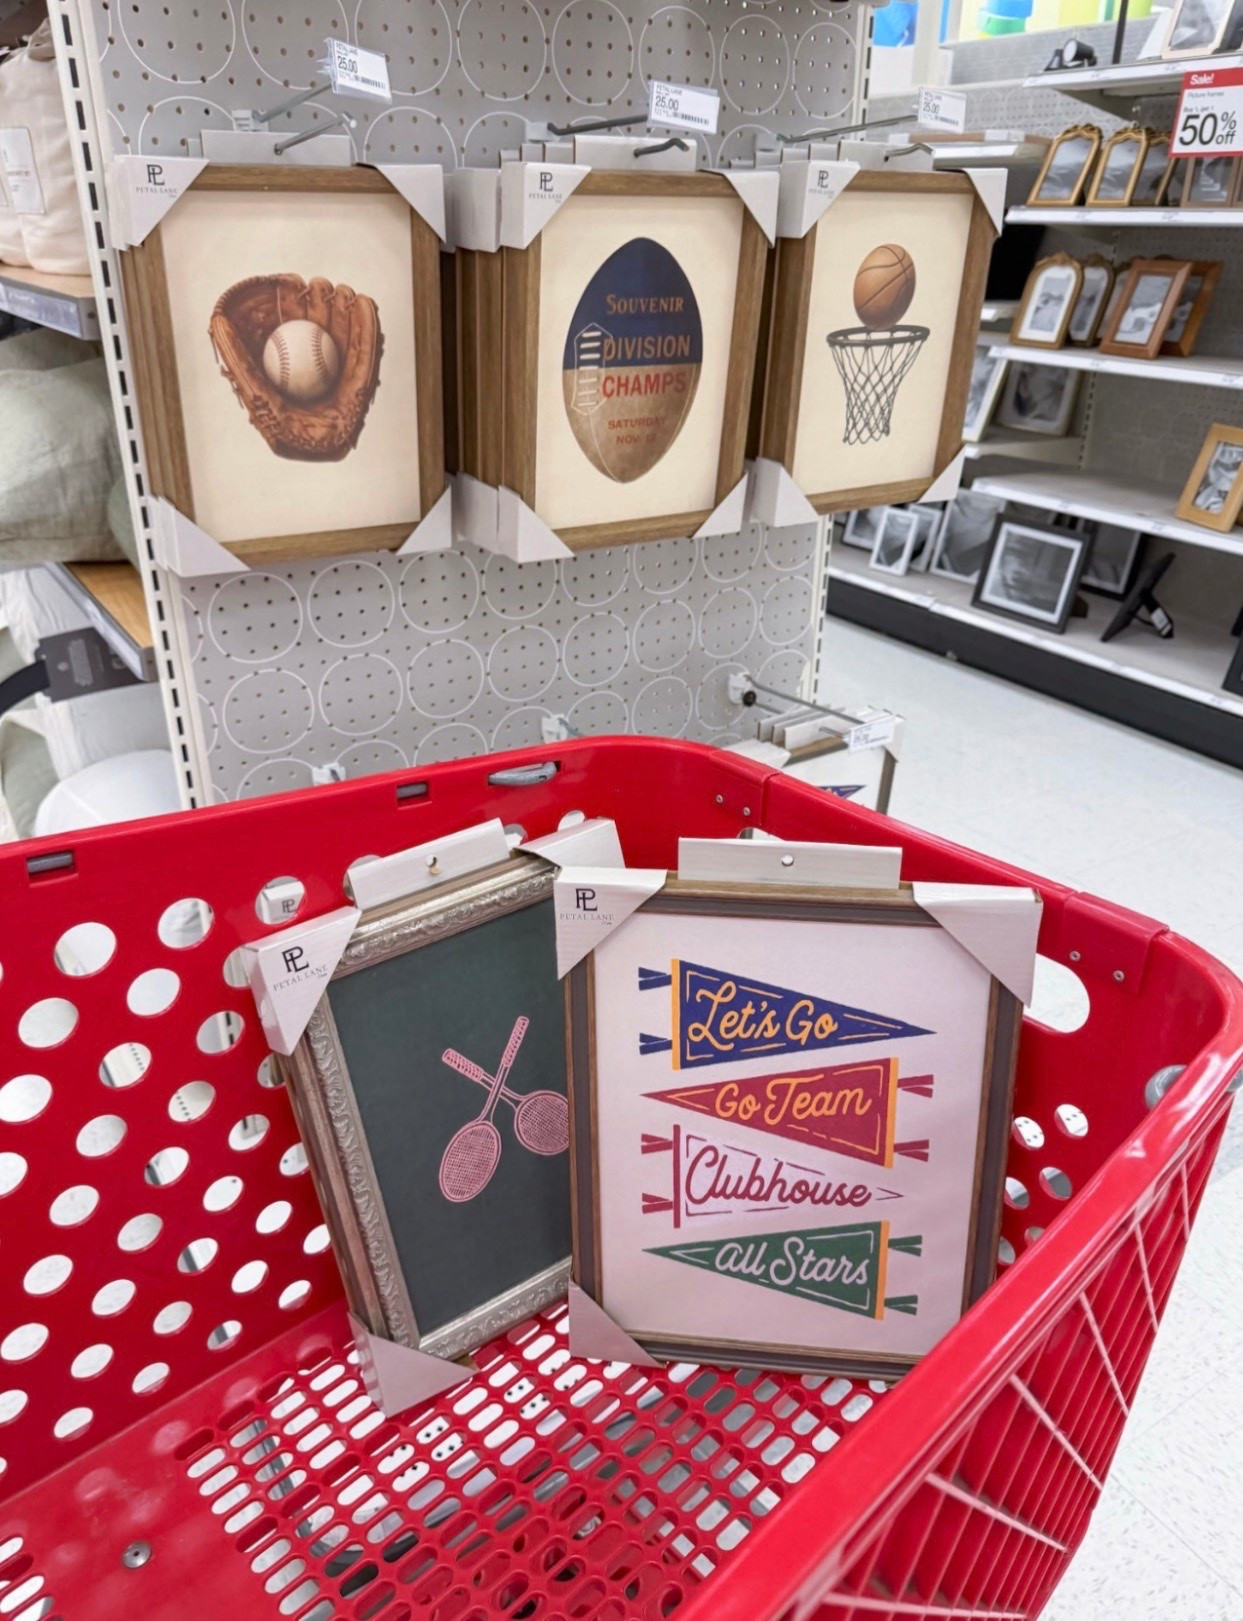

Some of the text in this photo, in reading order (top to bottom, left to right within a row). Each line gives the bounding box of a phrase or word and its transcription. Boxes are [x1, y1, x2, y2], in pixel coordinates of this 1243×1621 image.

[338, 55, 358, 74] 25.00
[1190, 73, 1215, 86] Sale!
[655, 95, 680, 112] 25.00
[1216, 130, 1236, 145] off
[606, 294, 684, 315] SOUVENIR
[603, 335, 691, 361] DIVISION
[602, 372, 688, 398] CHAMPS
[608, 417, 667, 430] SATURDAY
[272, 975, 302, 992] PETAL
[304, 964, 328, 979] LANE
[688, 980, 838, 1051] Let's Go
[715, 1074, 872, 1126] Go Team
[684, 1144, 873, 1208] Clubhouse
[769, 1236, 870, 1286] Stars
